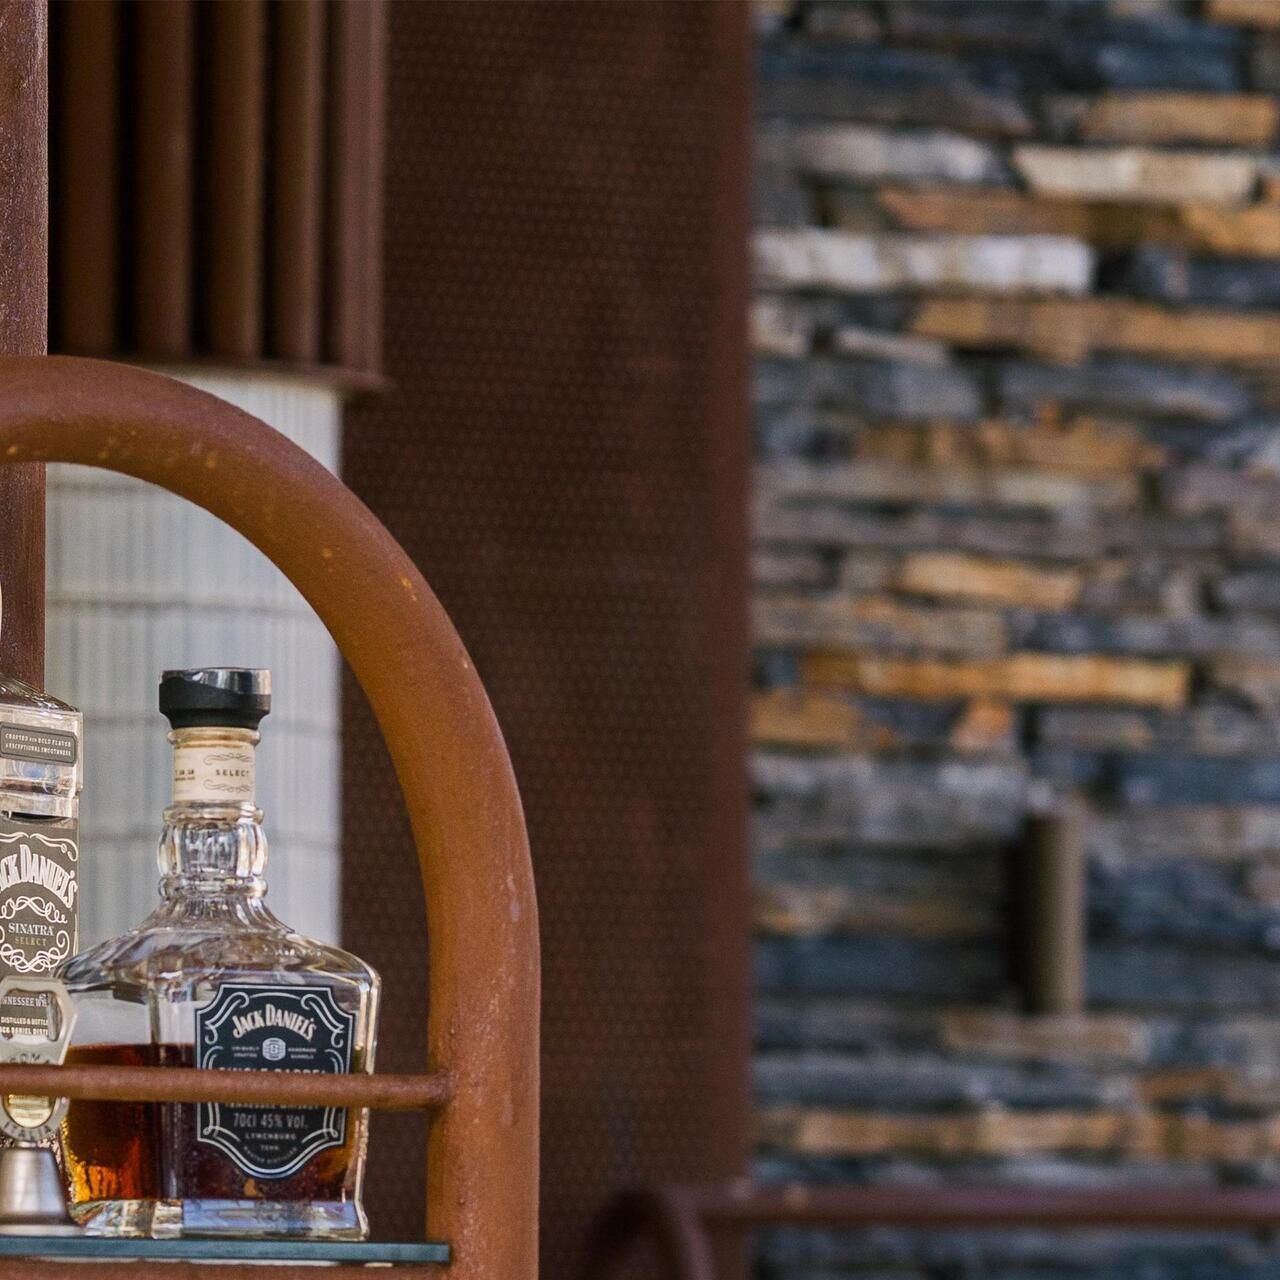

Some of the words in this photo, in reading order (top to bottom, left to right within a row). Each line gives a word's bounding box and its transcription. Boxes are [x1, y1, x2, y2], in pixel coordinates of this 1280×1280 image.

[5, 733, 29, 742] CRAFTED
[19, 844, 79, 909] DANIEL'S
[8, 922, 54, 936] SINATRA
[15, 938, 47, 947] SELECT
[232, 1009, 264, 1039] JACK
[265, 1003, 317, 1041] DANIEL'S
[261, 1113, 283, 1128] 45%
[245, 1132, 297, 1140] LYNCHBURG
